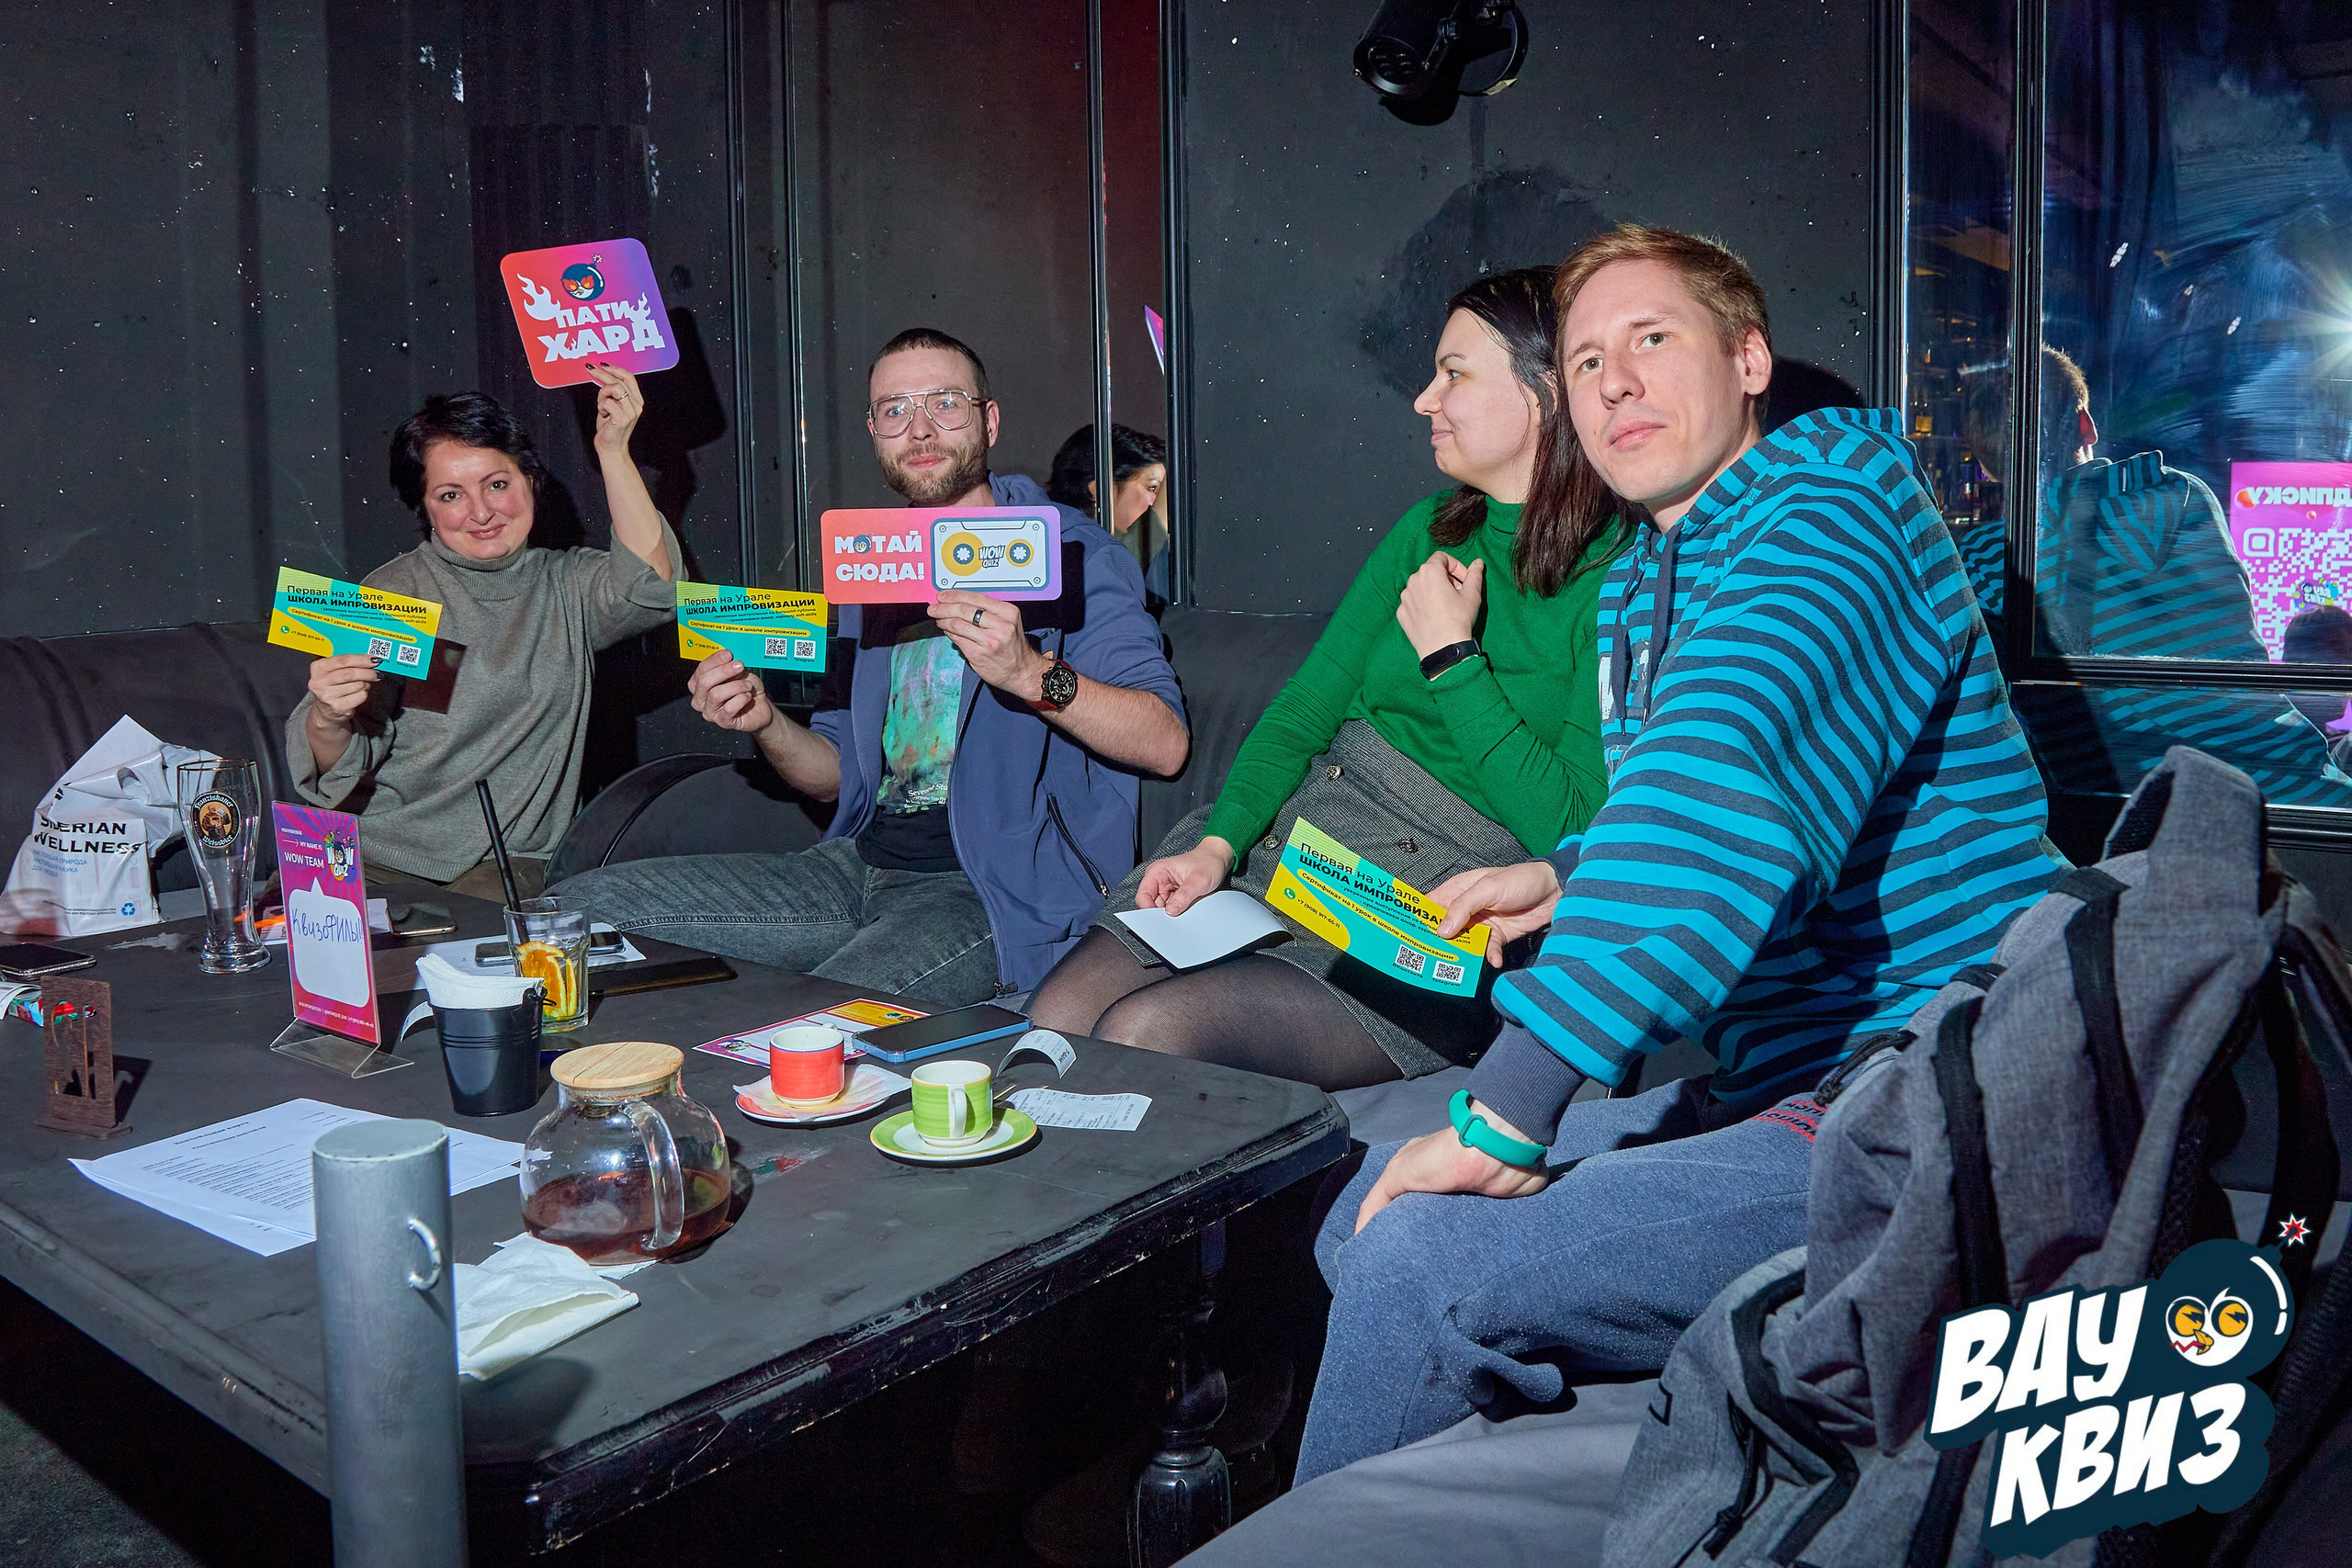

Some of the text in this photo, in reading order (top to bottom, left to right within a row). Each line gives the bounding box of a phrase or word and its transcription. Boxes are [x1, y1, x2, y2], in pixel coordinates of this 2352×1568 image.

[554, 300, 634, 329] ПАТИ
[537, 319, 665, 363] ХАРД
[978, 545, 1006, 560] WOW
[835, 562, 924, 583] СЮДА!
[982, 558, 999, 569] QUIZ
[288, 585, 329, 596] Первая
[347, 591, 384, 601] Урале
[684, 598, 717, 606] Первая
[735, 593, 771, 603] Урале
[288, 595, 426, 614] ШКОЛА ИМПРОВИЗАЦИИ
[686, 599, 815, 615] ШКОЛА ИМПРОВИЗАЦИИ
[291, 608, 322, 620] Сертификат
[352, 624, 369, 632] школе
[370, 629, 413, 641] импровизации
[34, 831, 141, 854] WELLNESS
[59, 856, 87, 865] ПРИРОДА
[284, 852, 324, 869] WOW TEAM
[327, 845, 355, 866] WOW
[334, 863, 348, 877] QUIZ
[1301, 842, 1420, 904] Первая на Урале
[1299, 854, 1470, 933] ШКОЛА ИМПРОВИЗА
[1302, 872, 1341, 900] Сертификат
[1342, 898, 1351, 907] на
[1355, 906, 1372, 919] урок
[1378, 920, 1399, 936] школе
[1400, 934, 1453, 960] импровизации
[1343, 886, 1374, 903] уверенные
[1375, 901, 1411, 919] выступления
[1419, 919, 1438, 931] больш
[1393, 963, 1424, 978] ВКонтакте
[1432, 978, 1461, 987] Telegram
